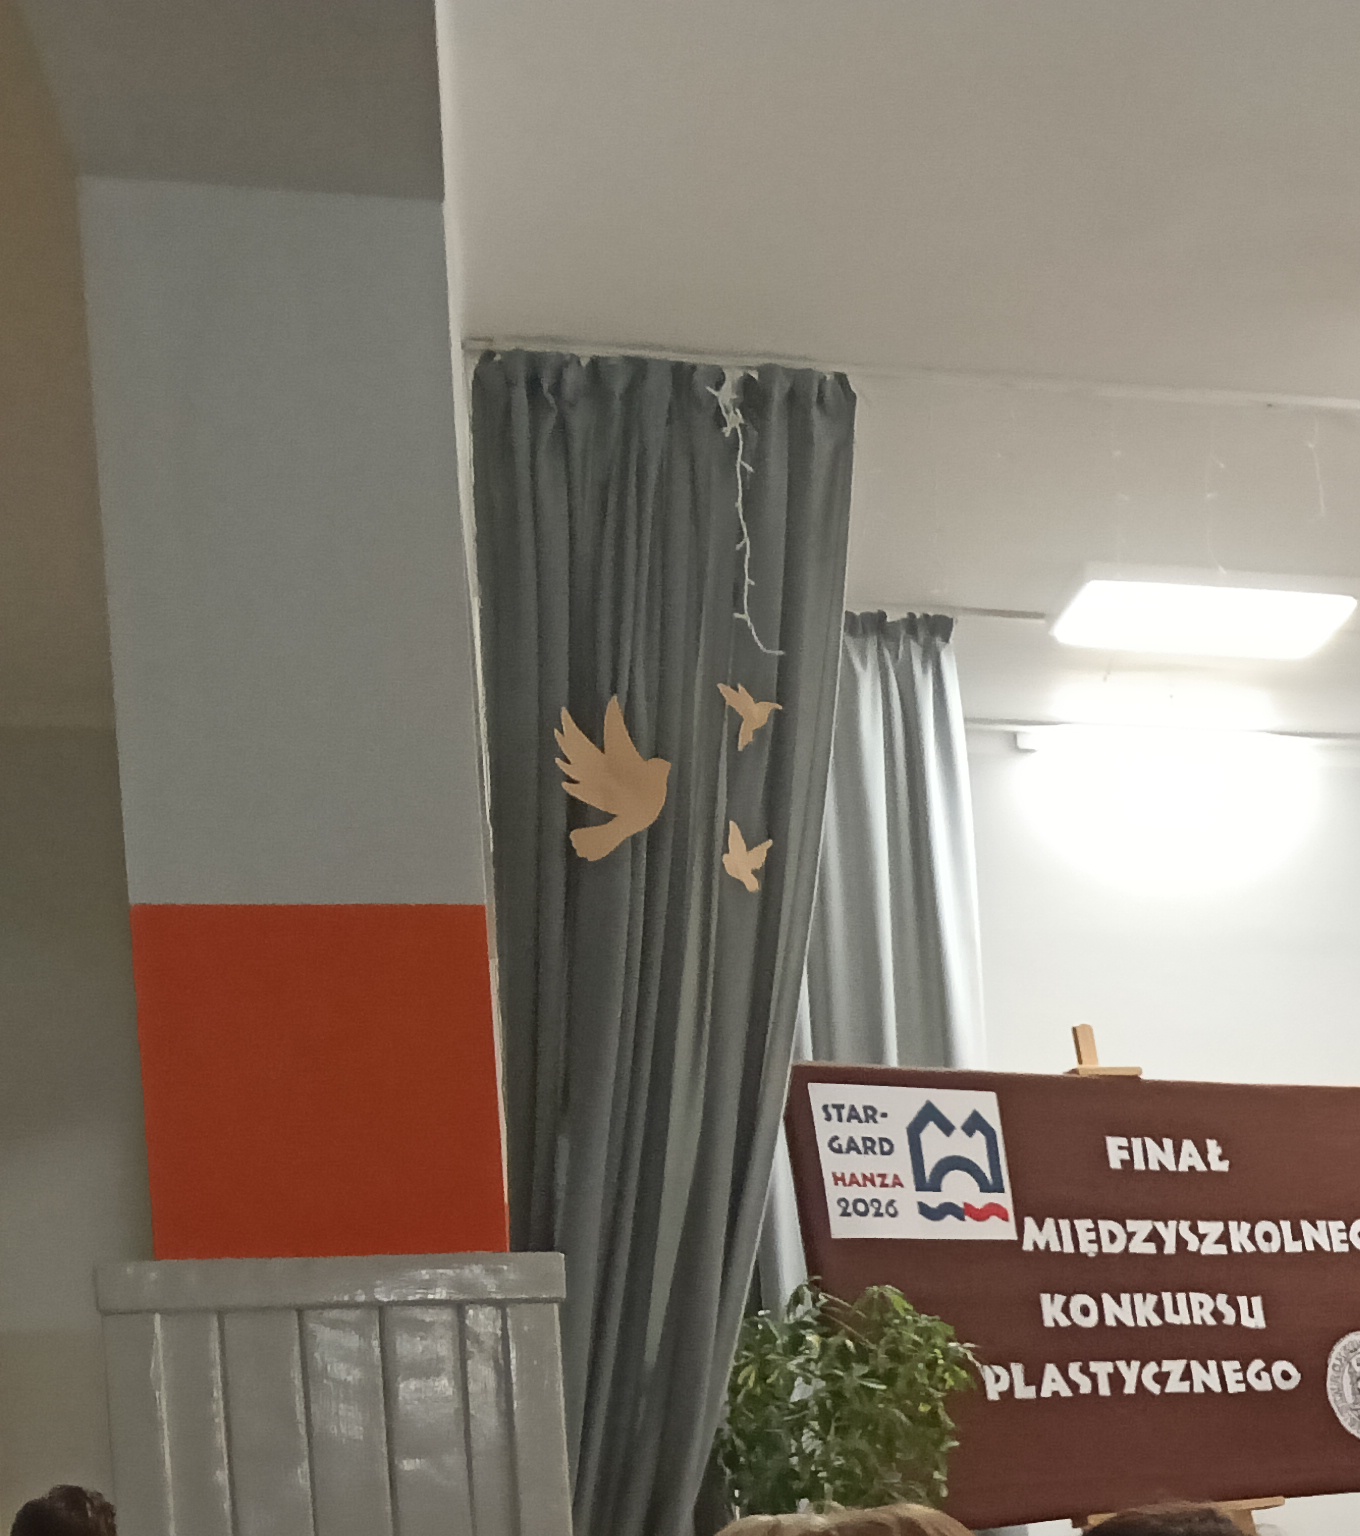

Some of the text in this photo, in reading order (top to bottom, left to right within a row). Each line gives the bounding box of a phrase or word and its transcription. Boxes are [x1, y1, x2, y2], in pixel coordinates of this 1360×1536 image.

[821, 1103, 889, 1124] STAR-
[827, 1134, 895, 1156] GARD
[1105, 1135, 1230, 1172] FINAŁ
[831, 1171, 905, 1189] HANZA
[836, 1197, 899, 1218] 2026
[1040, 1291, 1266, 1329] KONKURSU
[982, 1359, 1301, 1401] PLASTYCZNEGO
